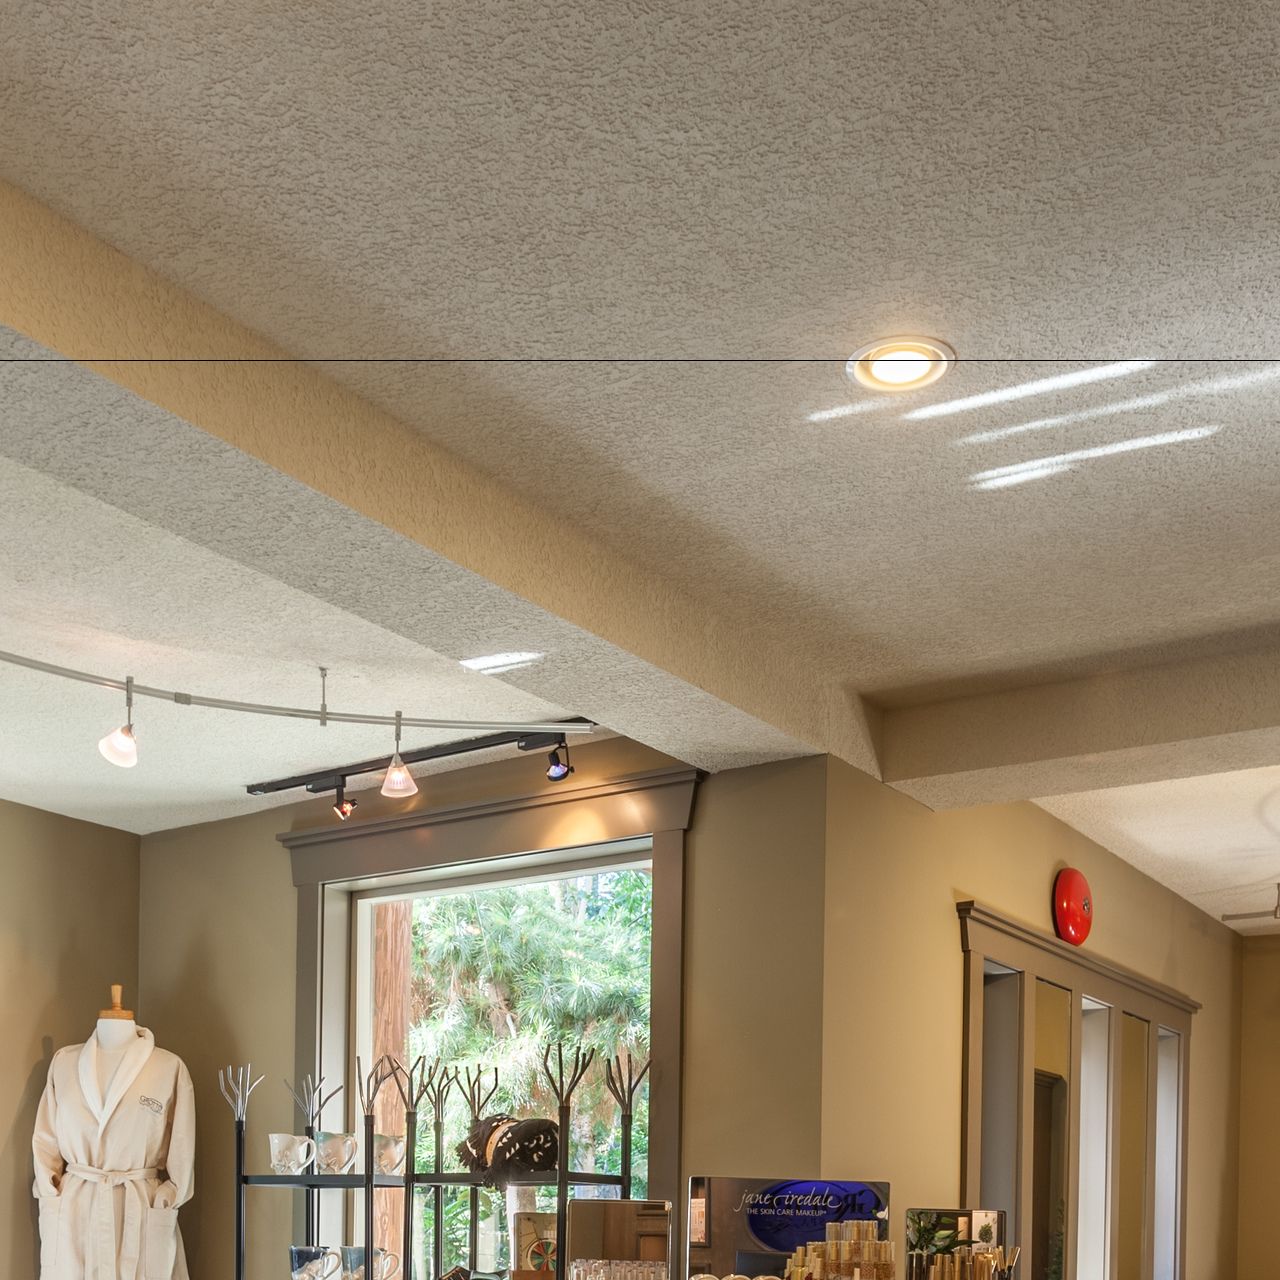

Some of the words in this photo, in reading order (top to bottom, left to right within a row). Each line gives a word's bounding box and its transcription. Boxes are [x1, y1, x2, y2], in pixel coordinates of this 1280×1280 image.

[733, 1189, 771, 1212] jane
[773, 1187, 842, 1208] iredale
[760, 1208, 775, 1216] SKIN
[776, 1208, 794, 1216] CARE
